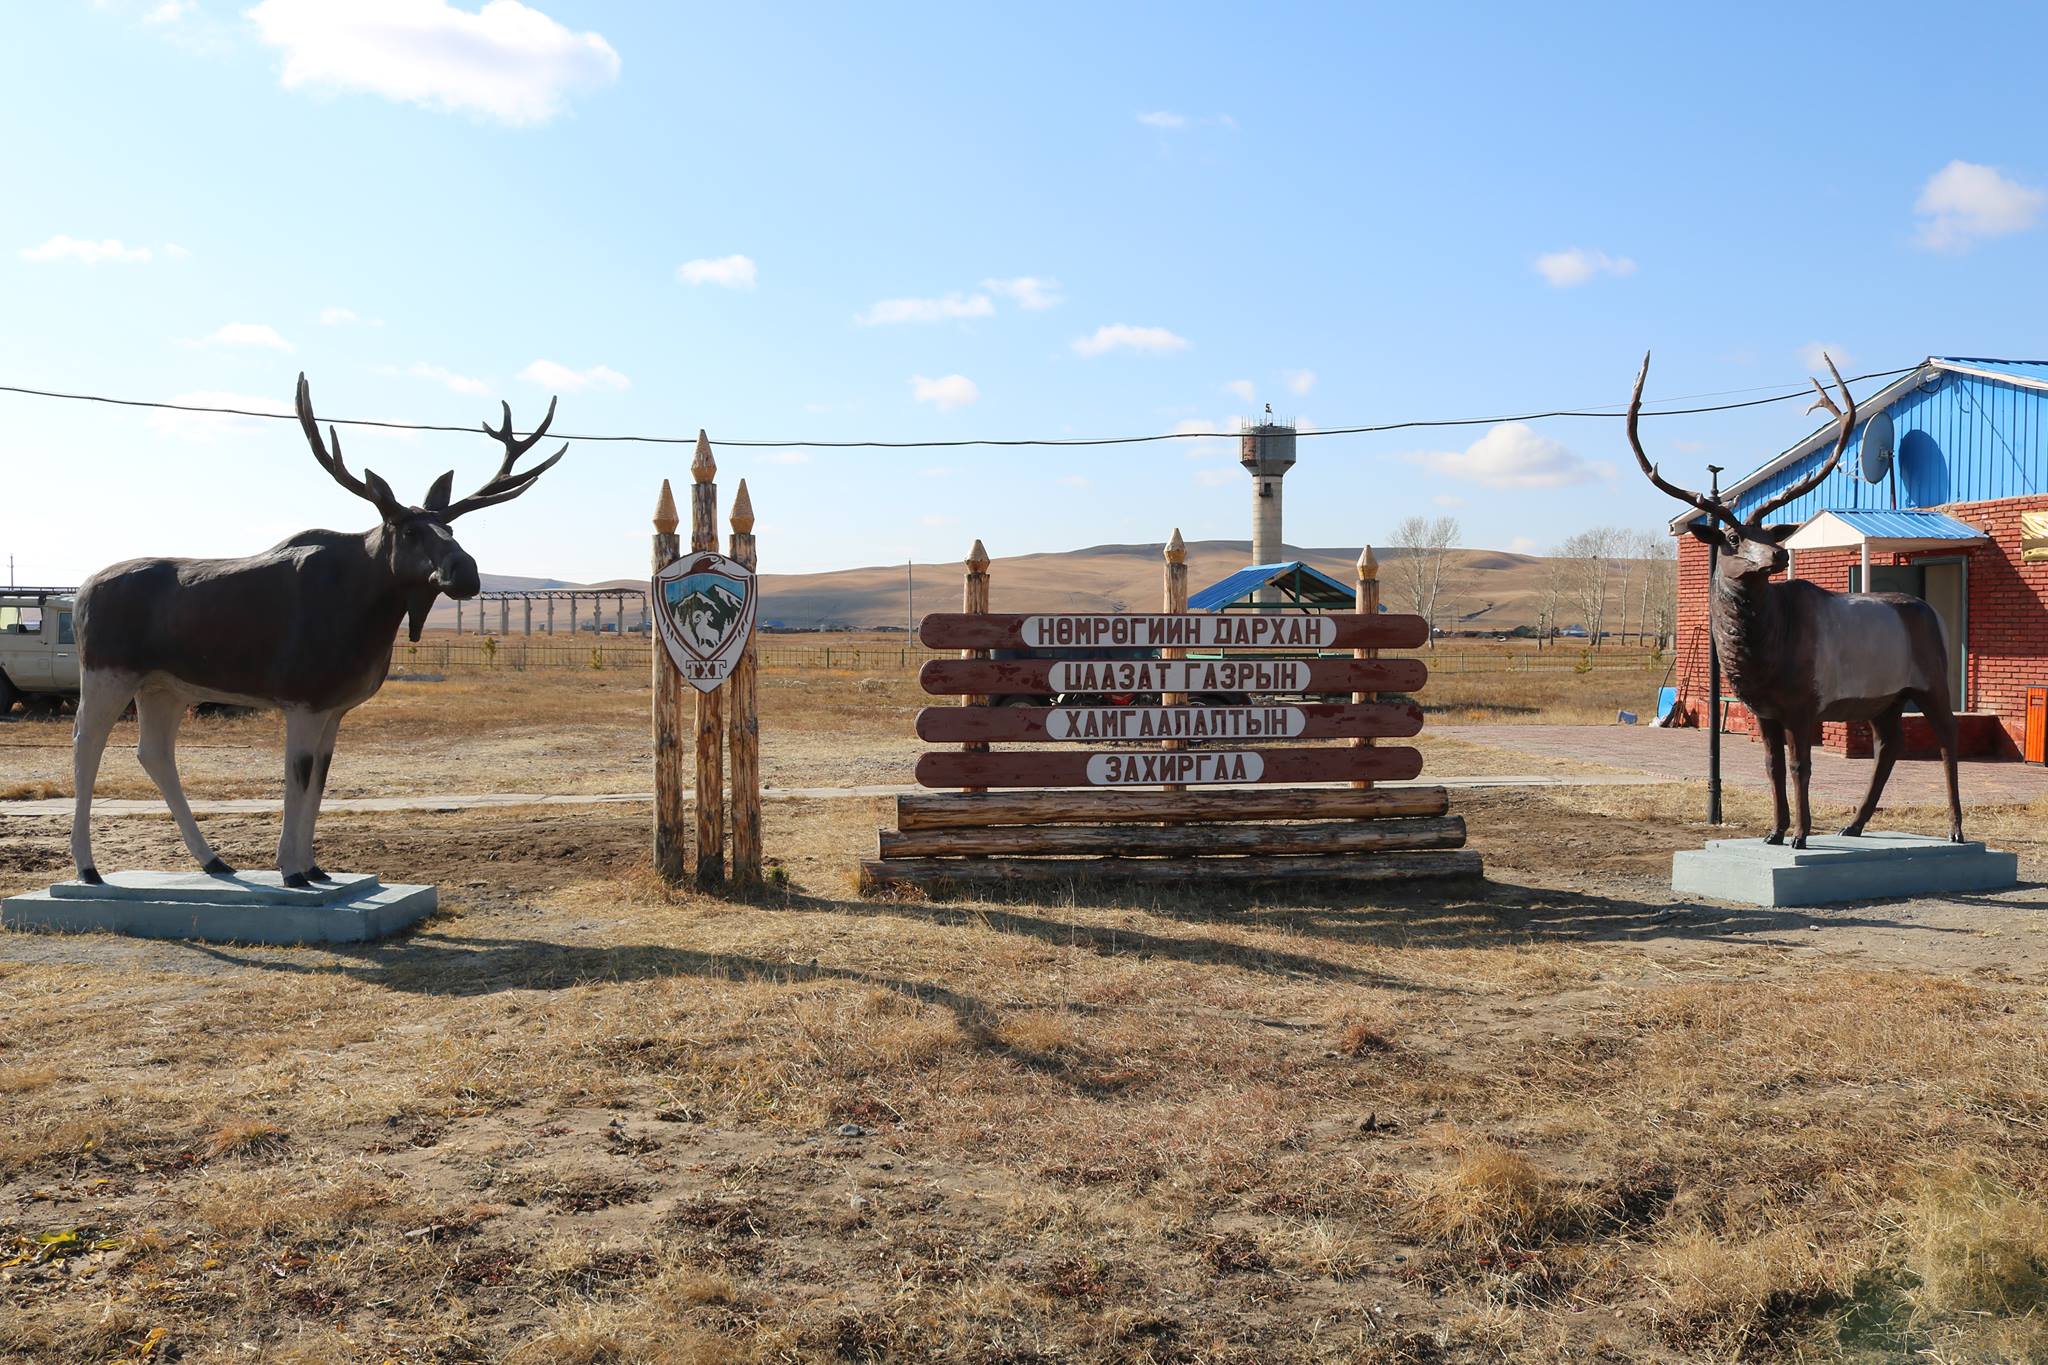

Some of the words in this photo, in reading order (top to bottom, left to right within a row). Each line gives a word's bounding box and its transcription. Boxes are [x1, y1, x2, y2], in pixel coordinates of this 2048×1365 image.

[1038, 617, 1201, 645] НӨМРӨГИИН
[1213, 617, 1322, 645] ДАРХАН
[1064, 662, 1172, 691] ЦААЗАТ
[1184, 662, 1297, 690] ГАЗРЫН
[1065, 708, 1288, 738] ХАМГААЛАЛТЫН
[1105, 754, 1248, 783] ЗАХИРГАА
